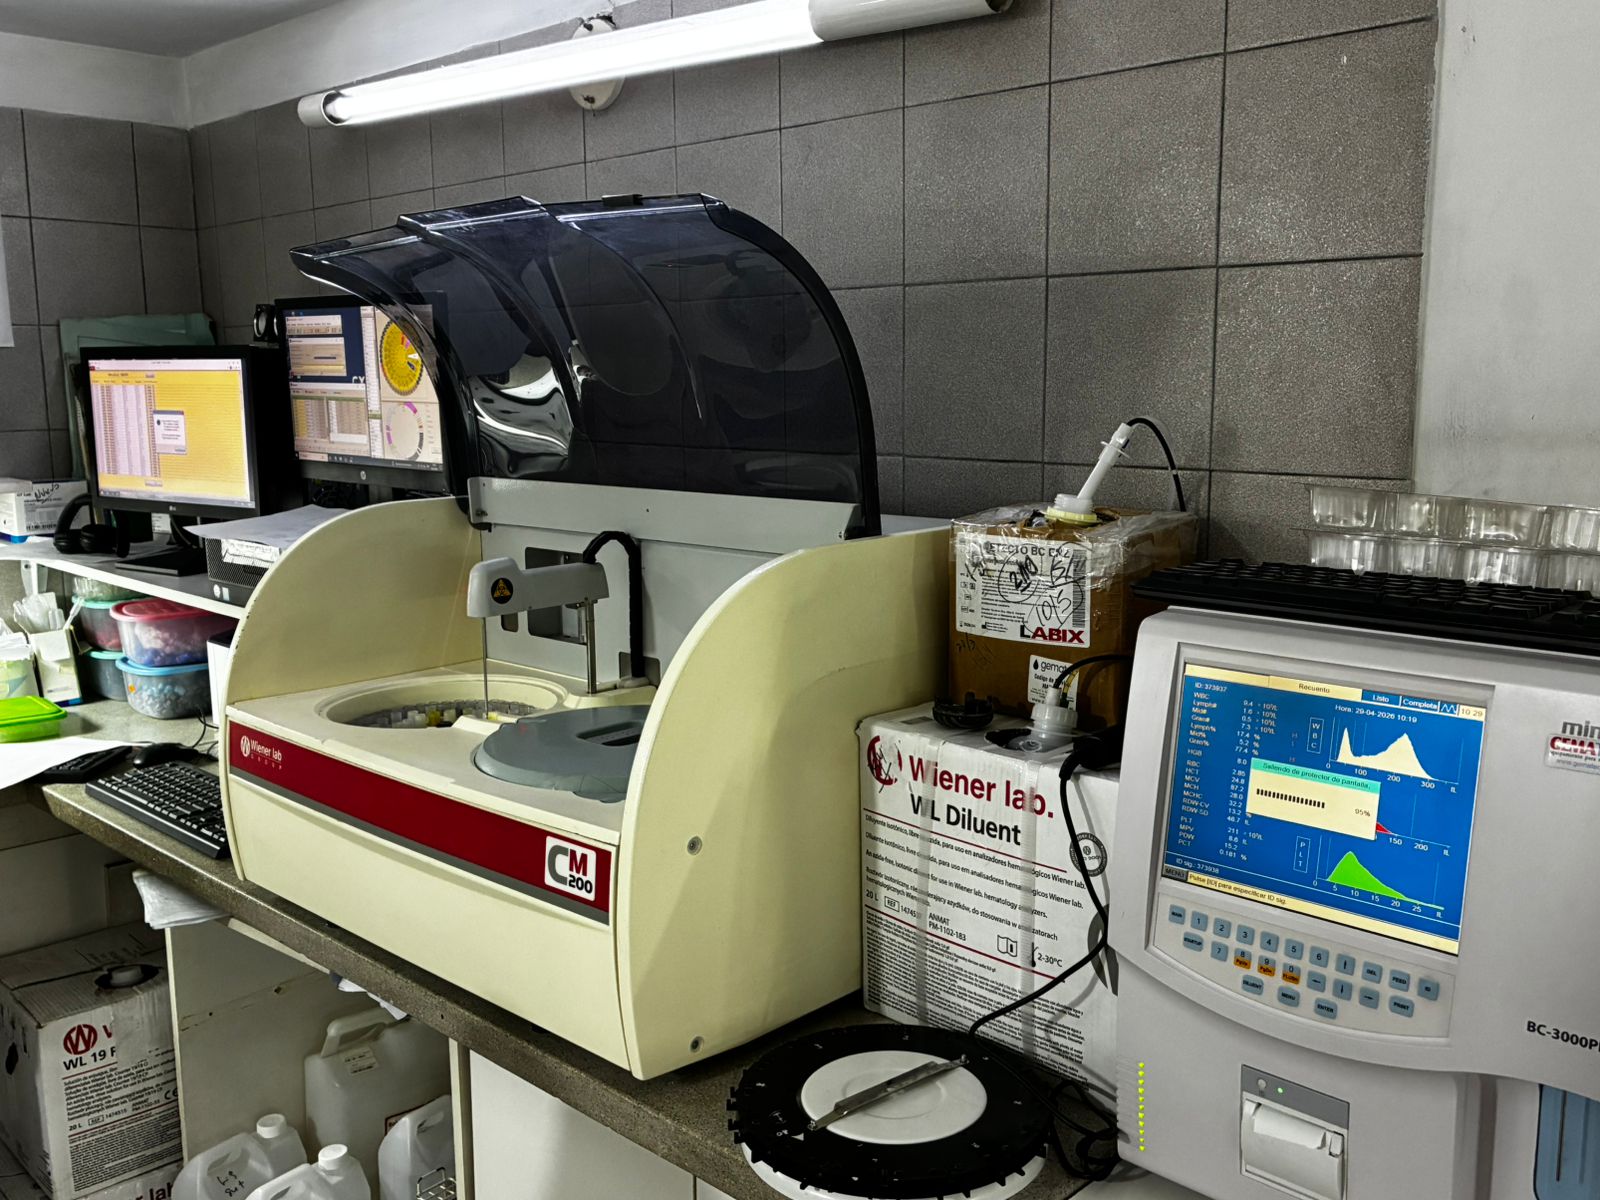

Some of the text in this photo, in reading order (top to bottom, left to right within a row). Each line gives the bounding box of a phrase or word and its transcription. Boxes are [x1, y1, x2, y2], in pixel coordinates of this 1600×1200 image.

[1020, 624, 1084, 644] LABIX
[1299, 683, 1330, 694] Recuento
[1372, 694, 1390, 703] Listo
[1335, 704, 1417, 723] Hora: 29-04-2026 10:19
[251, 738, 282, 761] Wiener lab
[909, 755, 1054, 818] Wiener lab.
[1354, 768, 1367, 776] 100
[1421, 781, 1435, 789] 300
[910, 793, 1021, 845] WL Diluent
[1389, 837, 1428, 851] 150 200
[942, 842, 953, 850] para
[973, 851, 1006, 867] analizadores
[1052, 874, 1074, 887] Wiener
[1075, 879, 1086, 889] lab.
[569, 874, 593, 894] 200
[939, 859, 950, 868] para
[951, 862, 960, 870] uso
[971, 869, 1004, 886] analisadores
[1049, 892, 1071, 906] Wiener
[1072, 898, 1083, 909] lab.
[939, 877, 948, 886] use
[954, 882, 973, 894] Wiener
[984, 892, 1017, 910] hematology
[1218, 882, 1232, 890] para
[928, 912, 950, 926] ANMAT
[980, 911, 1011, 926] stosowania
[928, 921, 966, 941] PM-1102-183
[1317, 1004, 1334, 1013] ENTER
[1527, 1020, 1600, 1052] BC-3000P
[63, 1050, 106, 1070] WL 19
